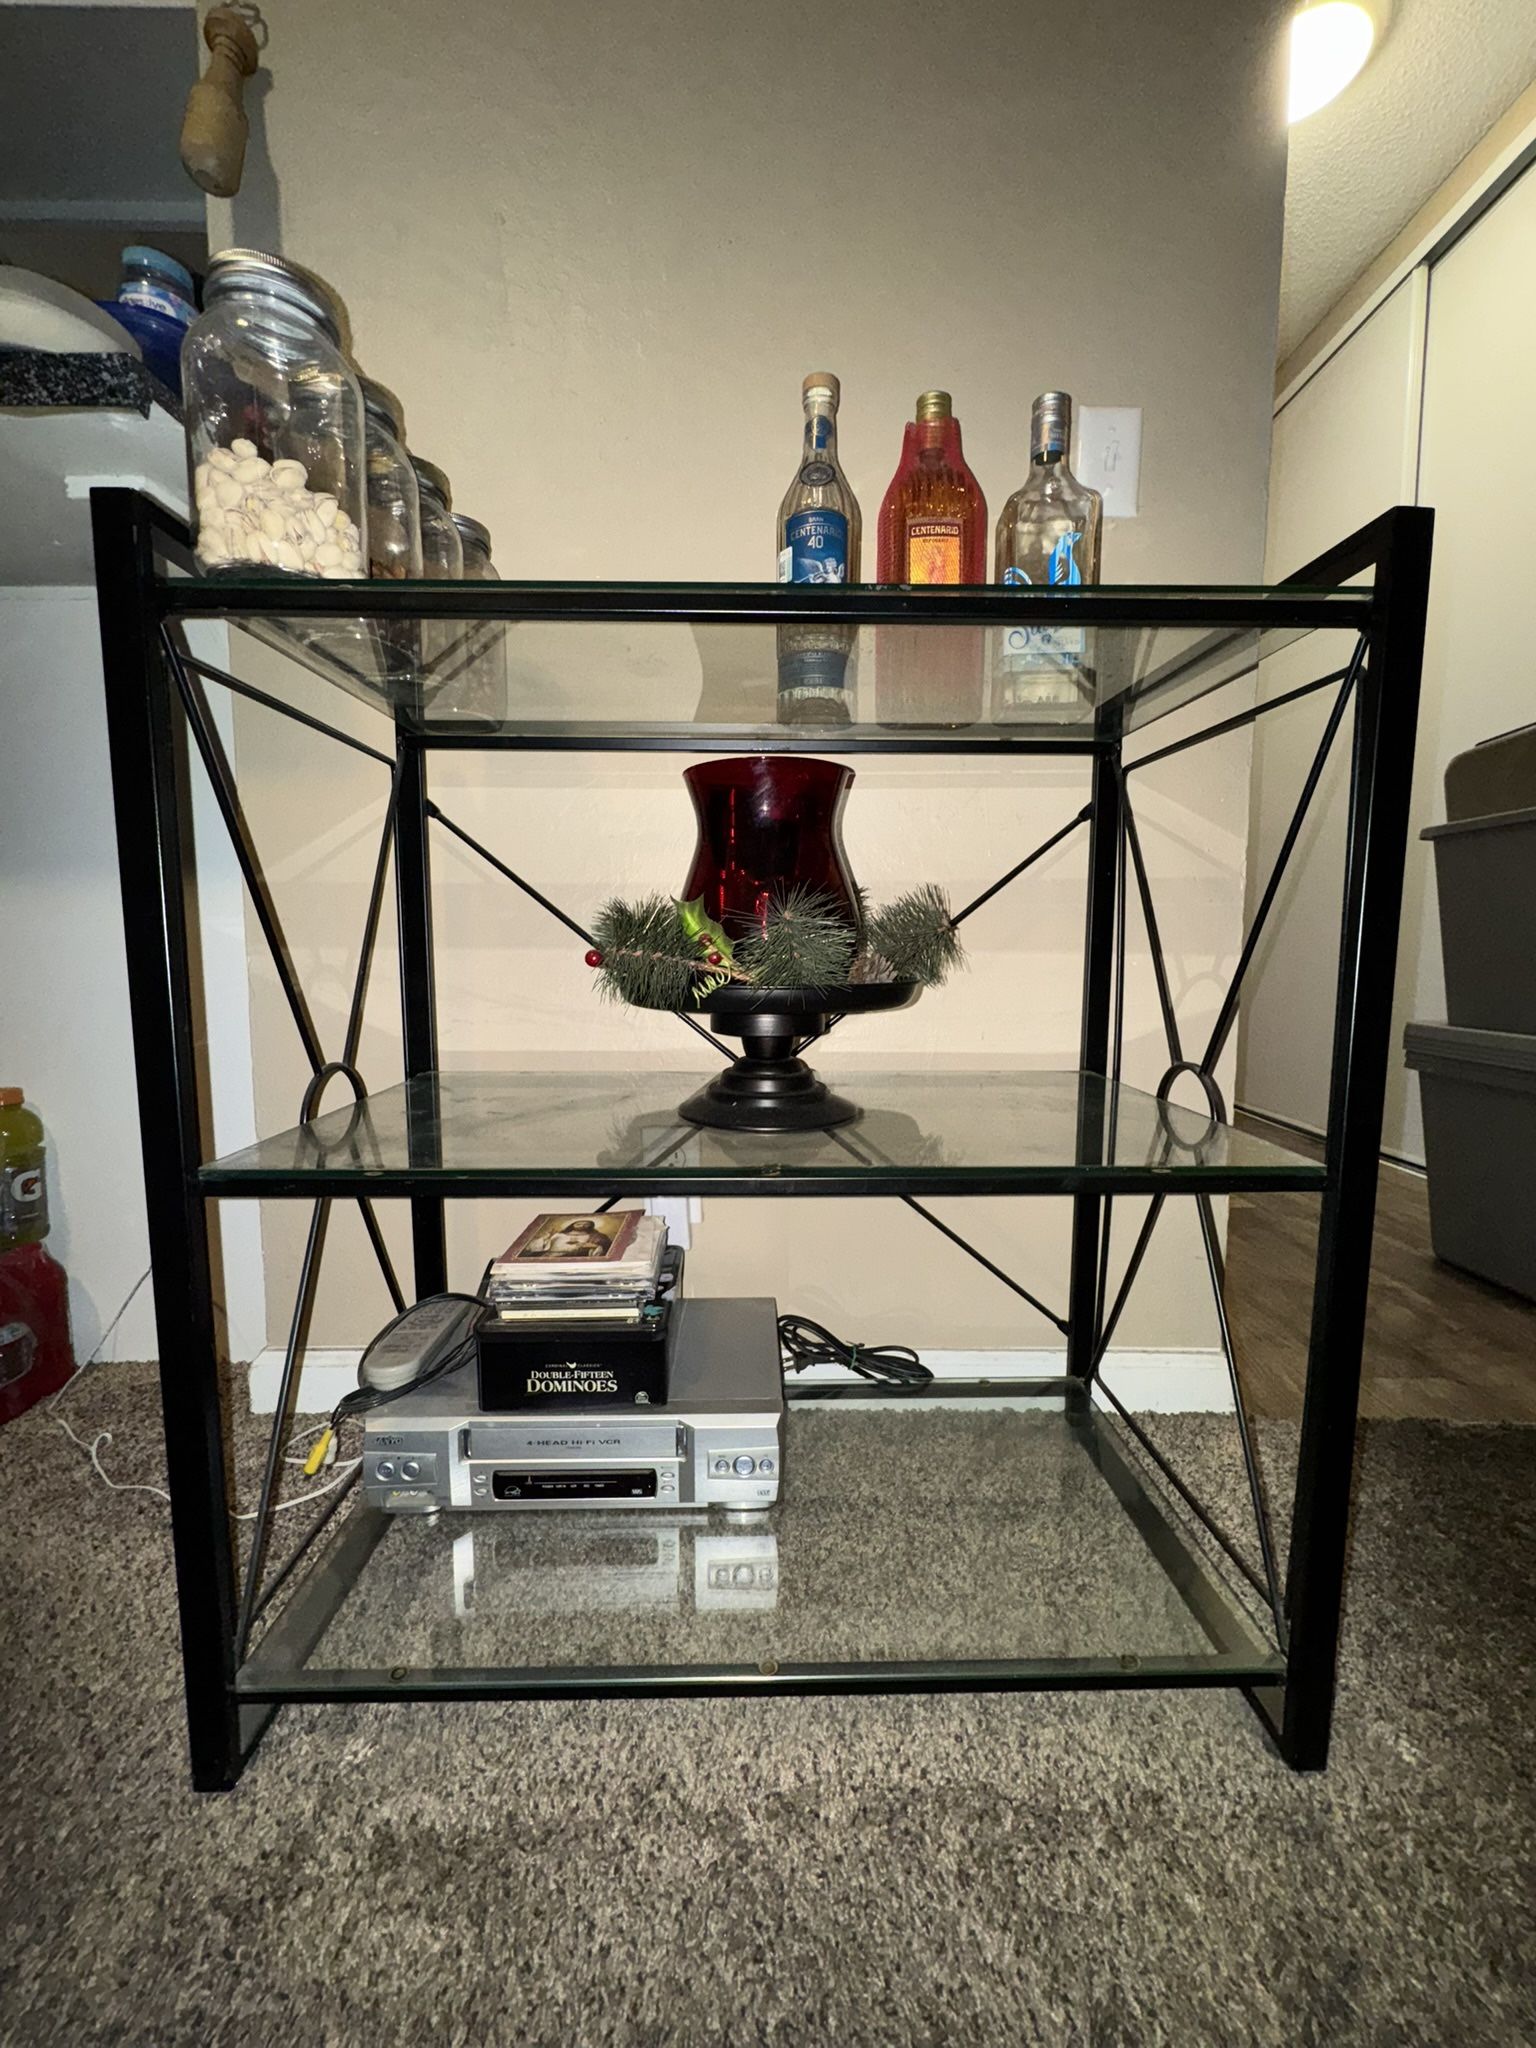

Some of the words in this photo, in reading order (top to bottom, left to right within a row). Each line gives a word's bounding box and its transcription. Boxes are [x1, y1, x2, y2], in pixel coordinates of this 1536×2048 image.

[911, 525, 959, 536] CENTENARIO
[807, 535, 824, 549] 40
[11, 1168, 42, 1202] G
[530, 1370, 614, 1379] DOUBLE-FIFTEEN
[526, 1378, 618, 1393] DOMINOES
